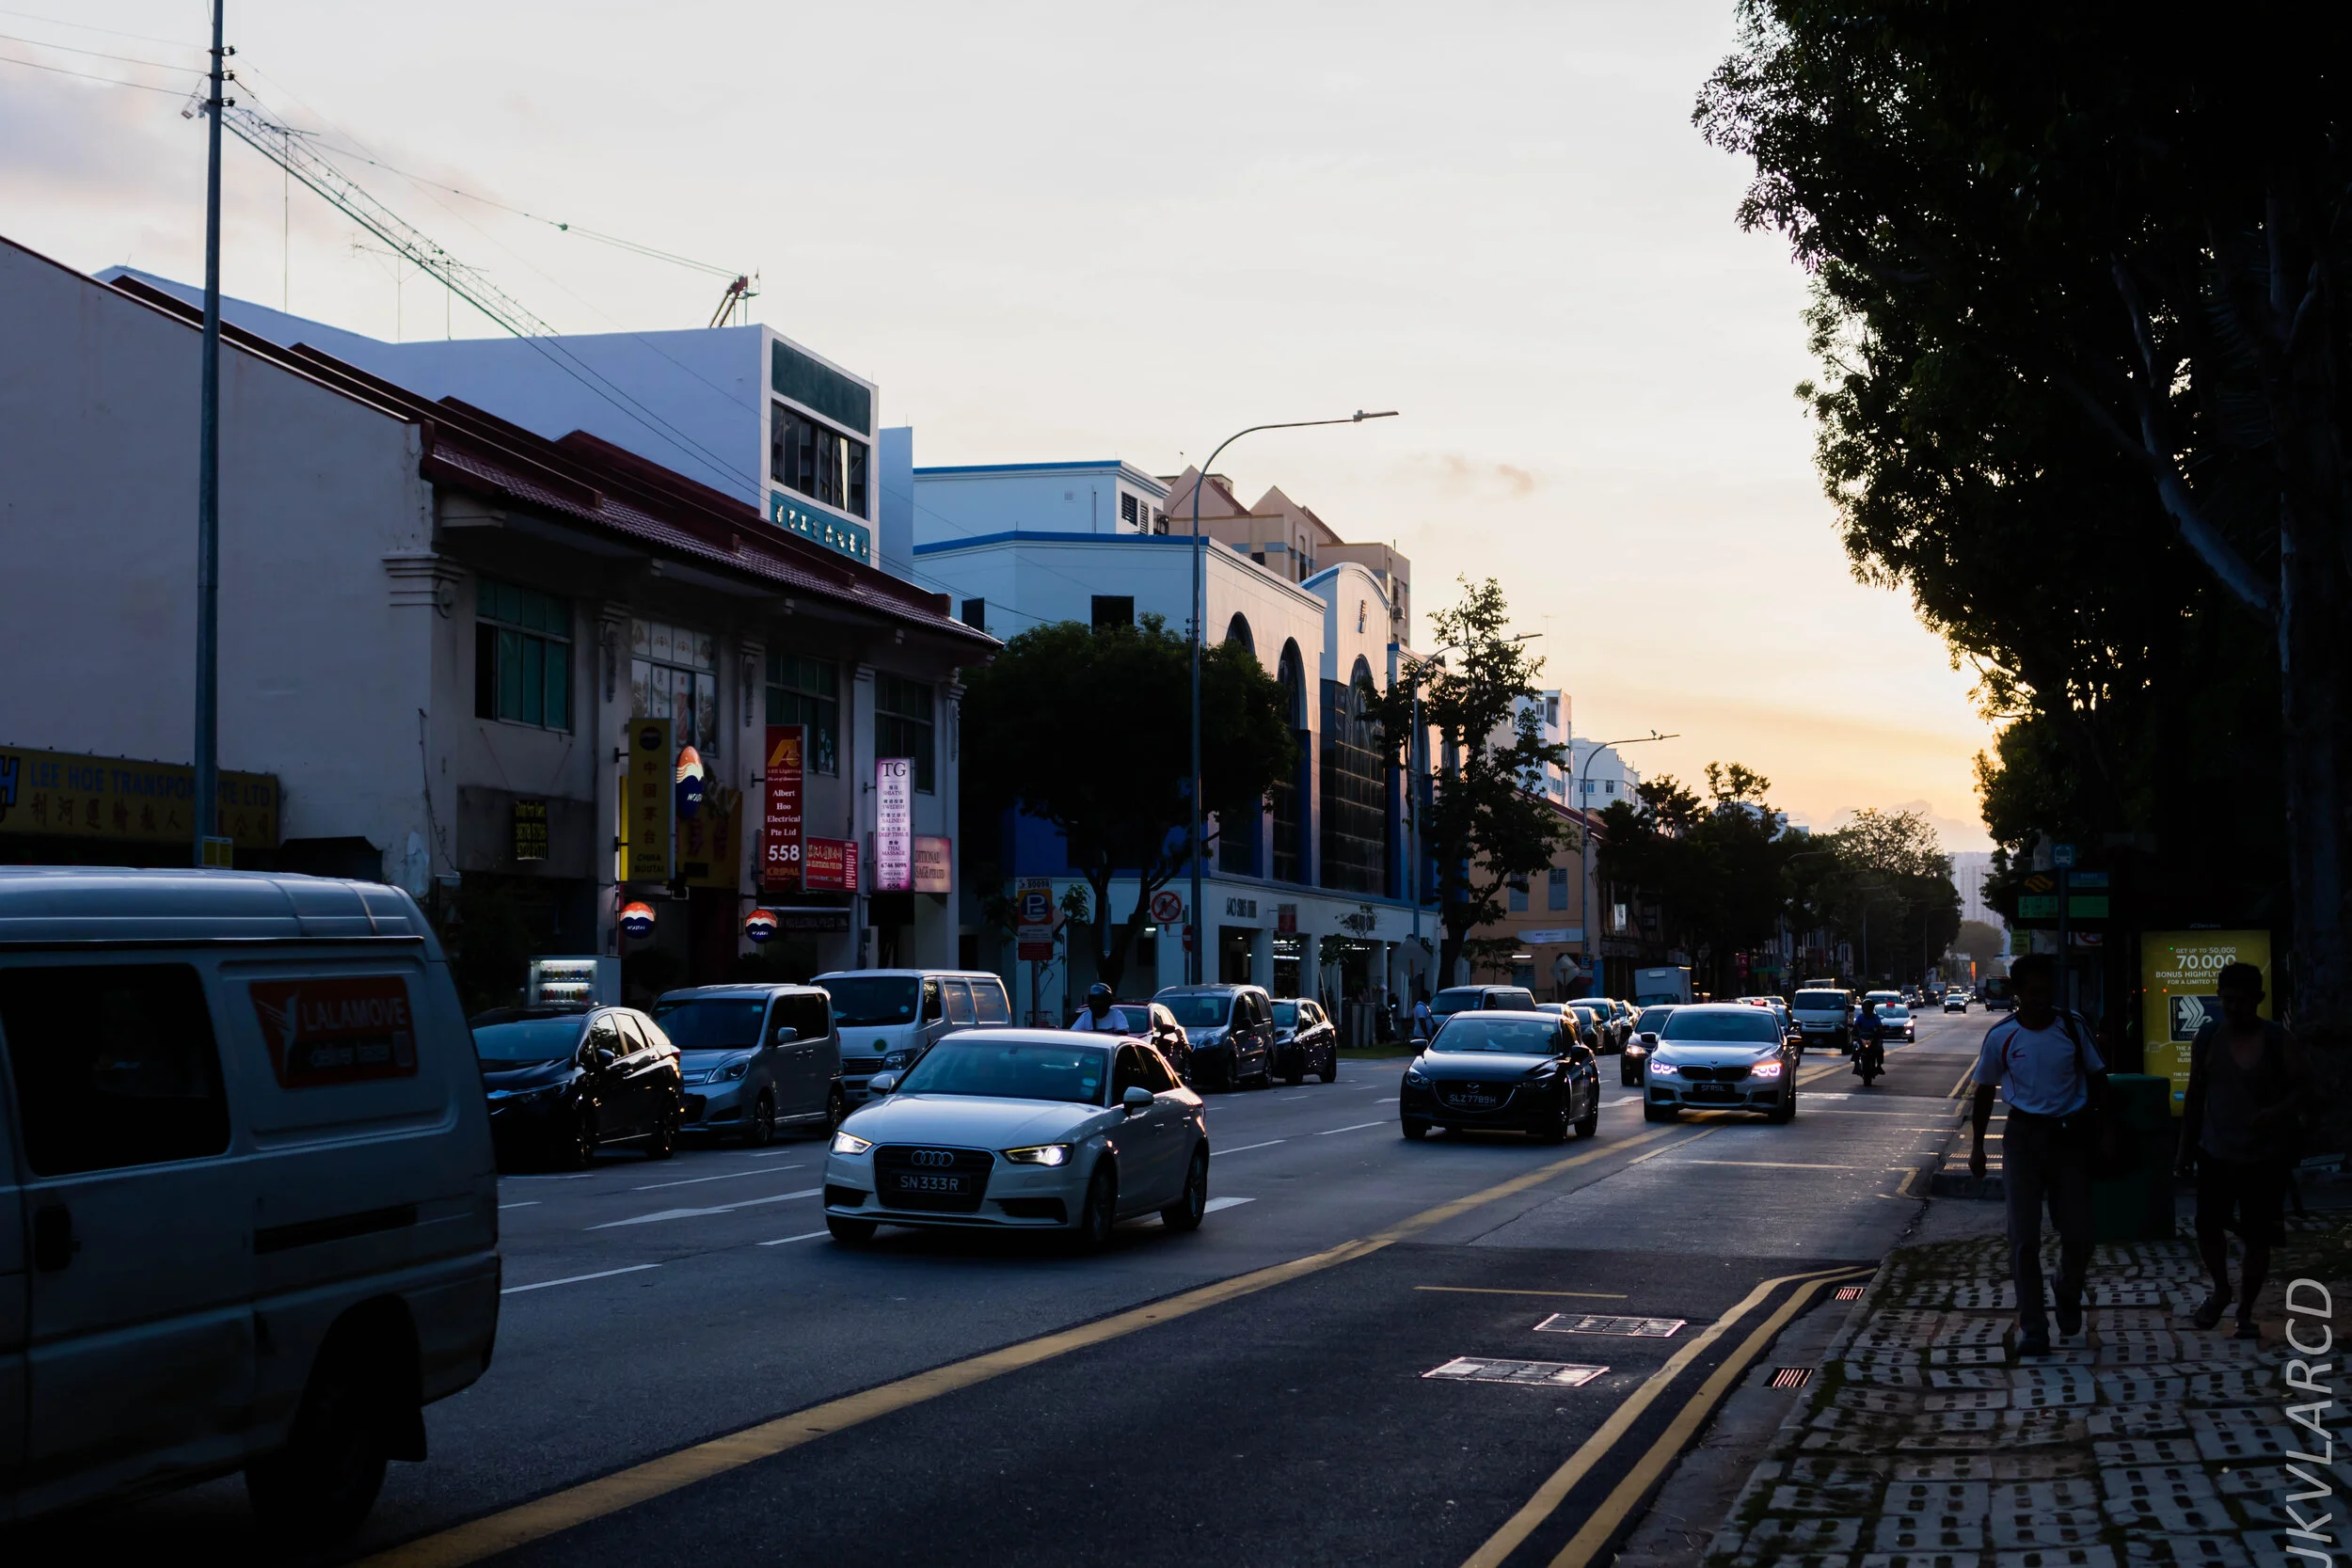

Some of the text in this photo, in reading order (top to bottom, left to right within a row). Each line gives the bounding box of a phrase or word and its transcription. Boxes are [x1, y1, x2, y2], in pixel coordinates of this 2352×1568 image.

[881, 762, 906, 777] TG
[30, 762, 60, 788] LEE
[69, 766, 104, 792] HOE
[111, 769, 196, 800] TRANSPOR
[244, 784, 271, 807] LTD
[772, 789, 796, 798] Albert
[767, 815, 801, 823] Electrical
[771, 828, 797, 836] Pte Ltd
[768, 844, 800, 862] 558
[2209, 946, 2236, 955] 50,000
[2176, 954, 2236, 970] 70,000
[302, 997, 407, 1032] LALAMOVE
[1449, 1094, 1496, 1104] SLZ7789H
[898, 1176, 959, 1192] SN333R
